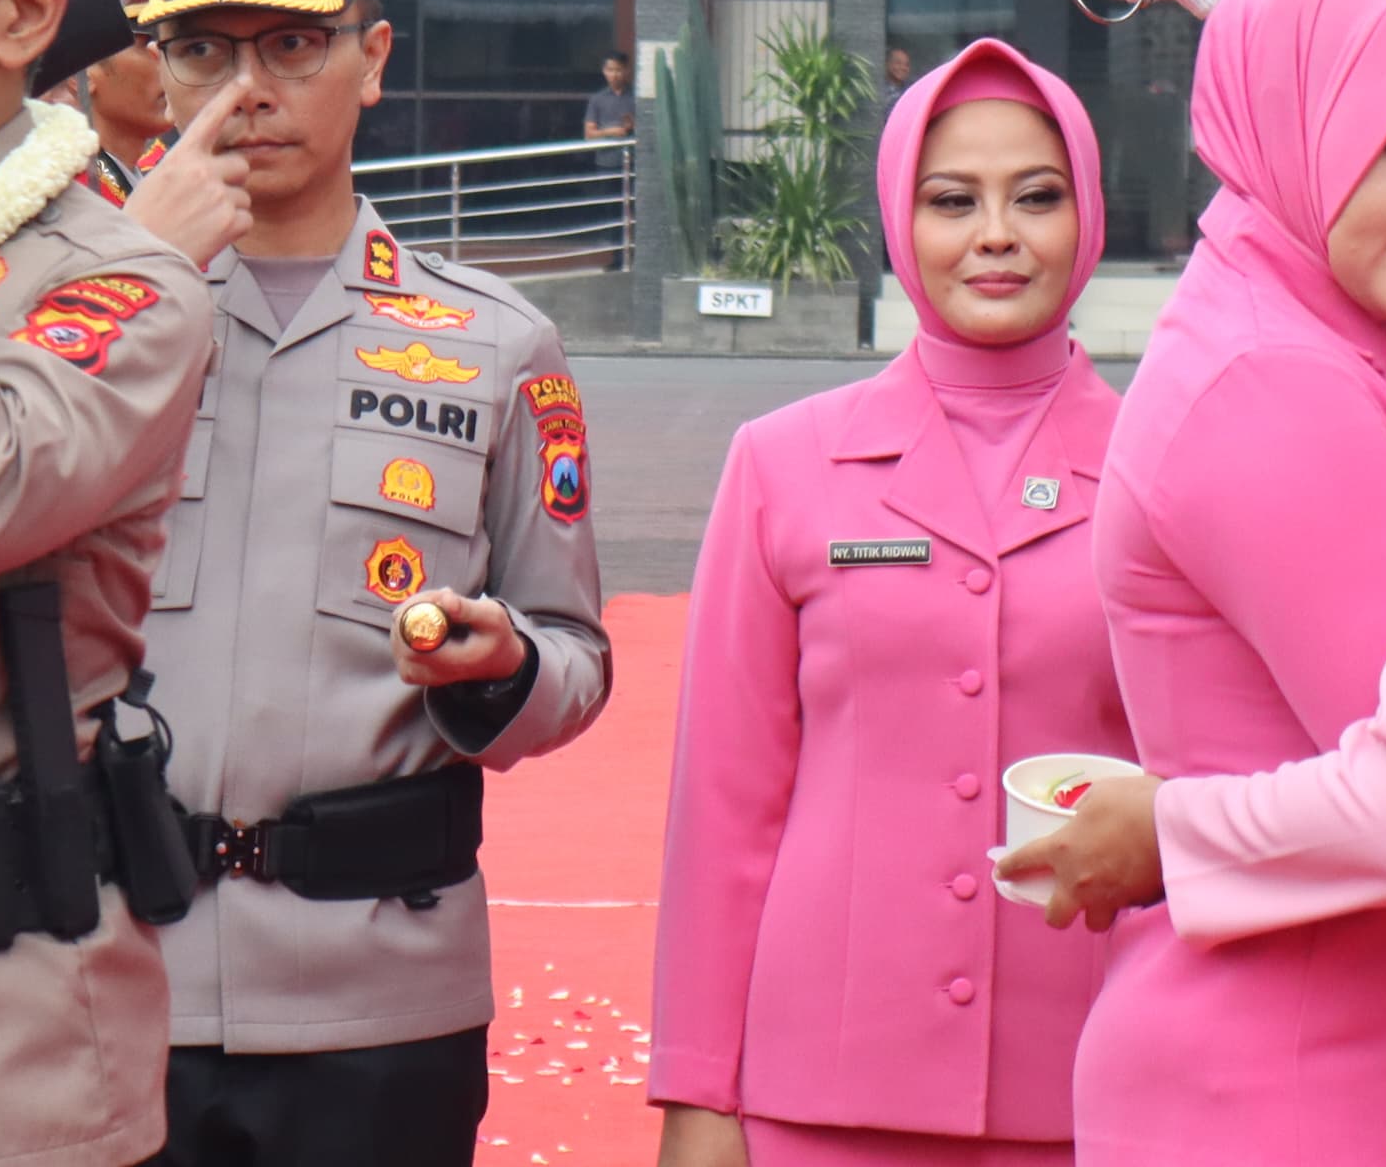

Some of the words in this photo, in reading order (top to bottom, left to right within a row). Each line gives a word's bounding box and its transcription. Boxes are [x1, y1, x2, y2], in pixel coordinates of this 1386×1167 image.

[711, 292, 762, 309] SPKT
[350, 389, 477, 442] POLRI
[390, 491, 425, 505] POLRI
[833, 547, 851, 559] NY.
[853, 546, 880, 558] TITIK
[881, 545, 926, 558] RIDWAN
